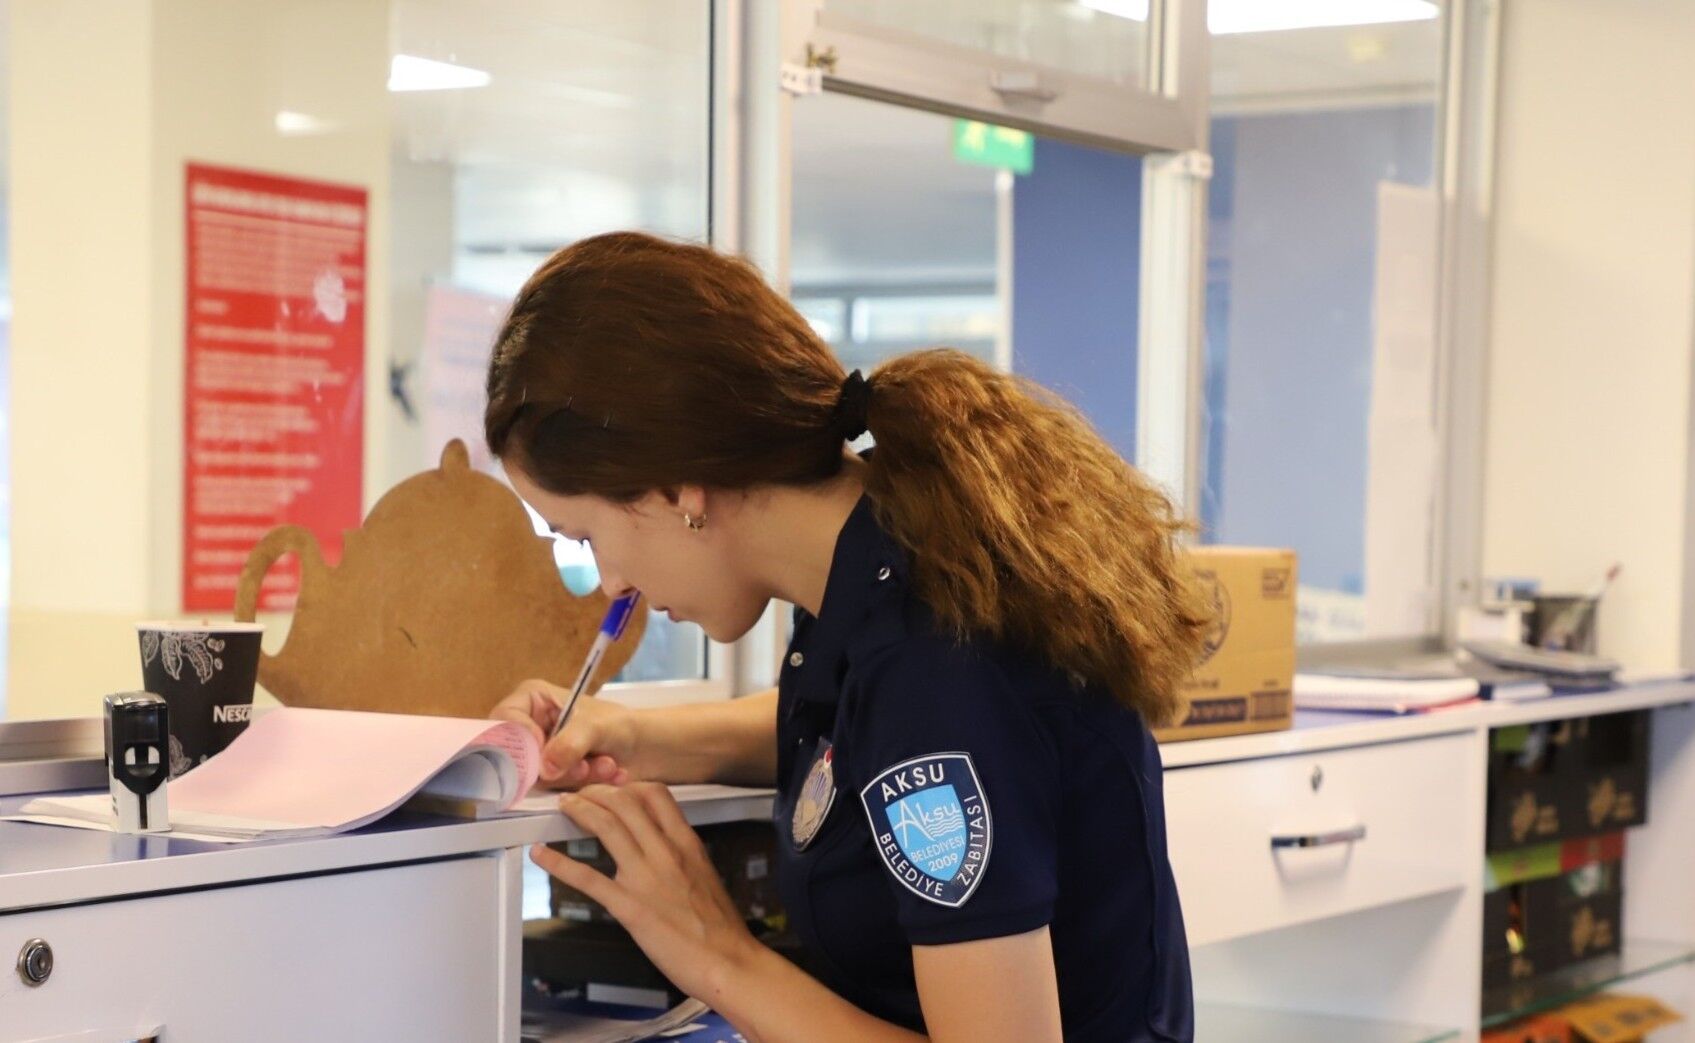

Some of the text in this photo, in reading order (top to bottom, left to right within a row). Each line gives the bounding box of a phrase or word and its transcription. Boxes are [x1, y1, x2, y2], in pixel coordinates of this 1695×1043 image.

[881, 763, 944, 801] AKSU
[894, 800, 961, 849] Aksu
[880, 832, 944, 897] BELEDİYE
[928, 853, 959, 872] 2009
